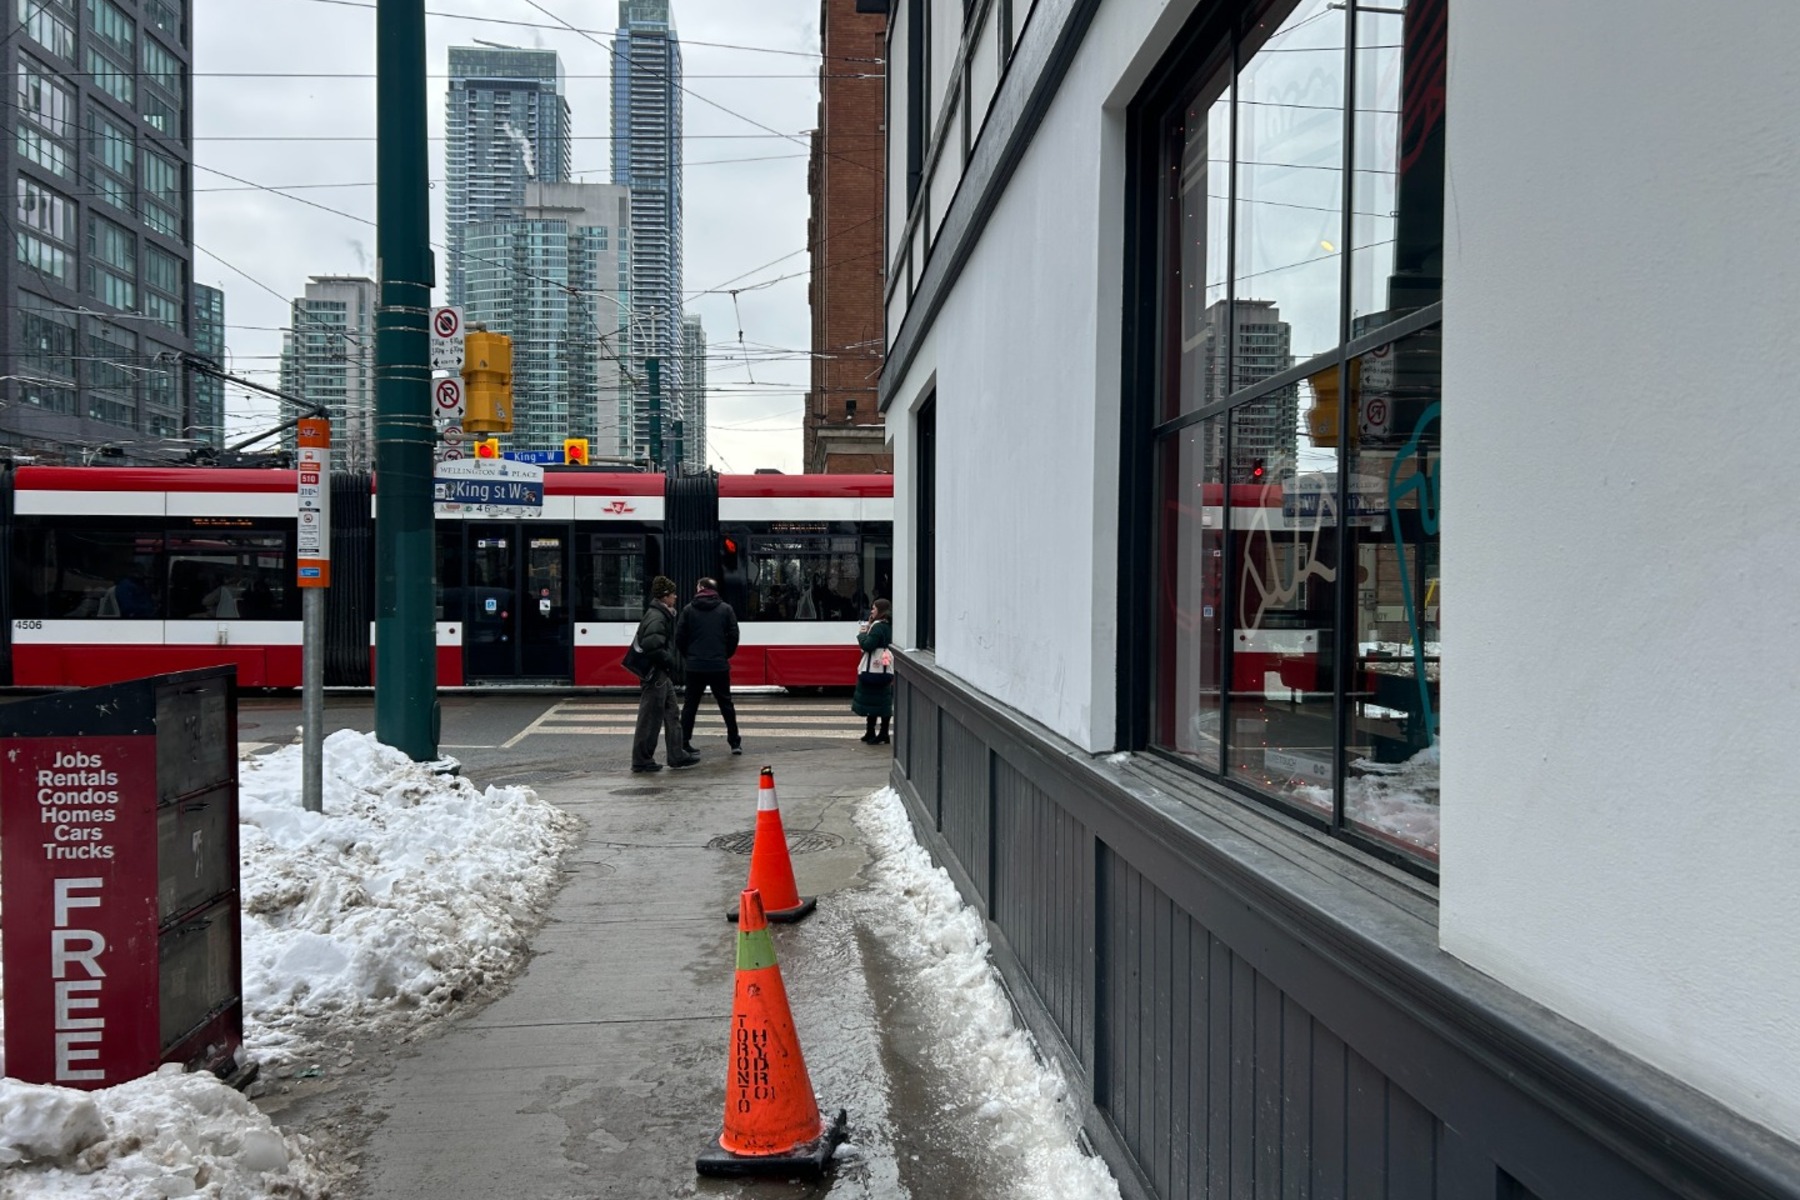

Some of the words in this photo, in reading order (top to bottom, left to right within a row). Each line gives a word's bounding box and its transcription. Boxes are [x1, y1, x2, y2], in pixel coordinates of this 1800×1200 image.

[514, 451, 536, 463] King
[547, 451, 555, 461] W
[301, 474, 316, 483] 510
[440, 466, 496, 476] WELLINGTON
[511, 470, 537, 478] PLACE
[456, 481, 489, 502] King
[494, 485, 505, 499] St
[509, 483, 522, 500] W
[15, 620, 42, 630] 4506
[53, 751, 102, 768] Jobs
[38, 769, 118, 786] Rentals
[37, 788, 119, 805] Condos
[41, 807, 116, 823] Homes
[54, 824, 103, 841] Cars
[42, 842, 115, 860] Trucks
[51, 877, 107, 1081] FREE
[737, 1014, 750, 1113] TORONTO
[752, 1028, 769, 1100] HYDRO
